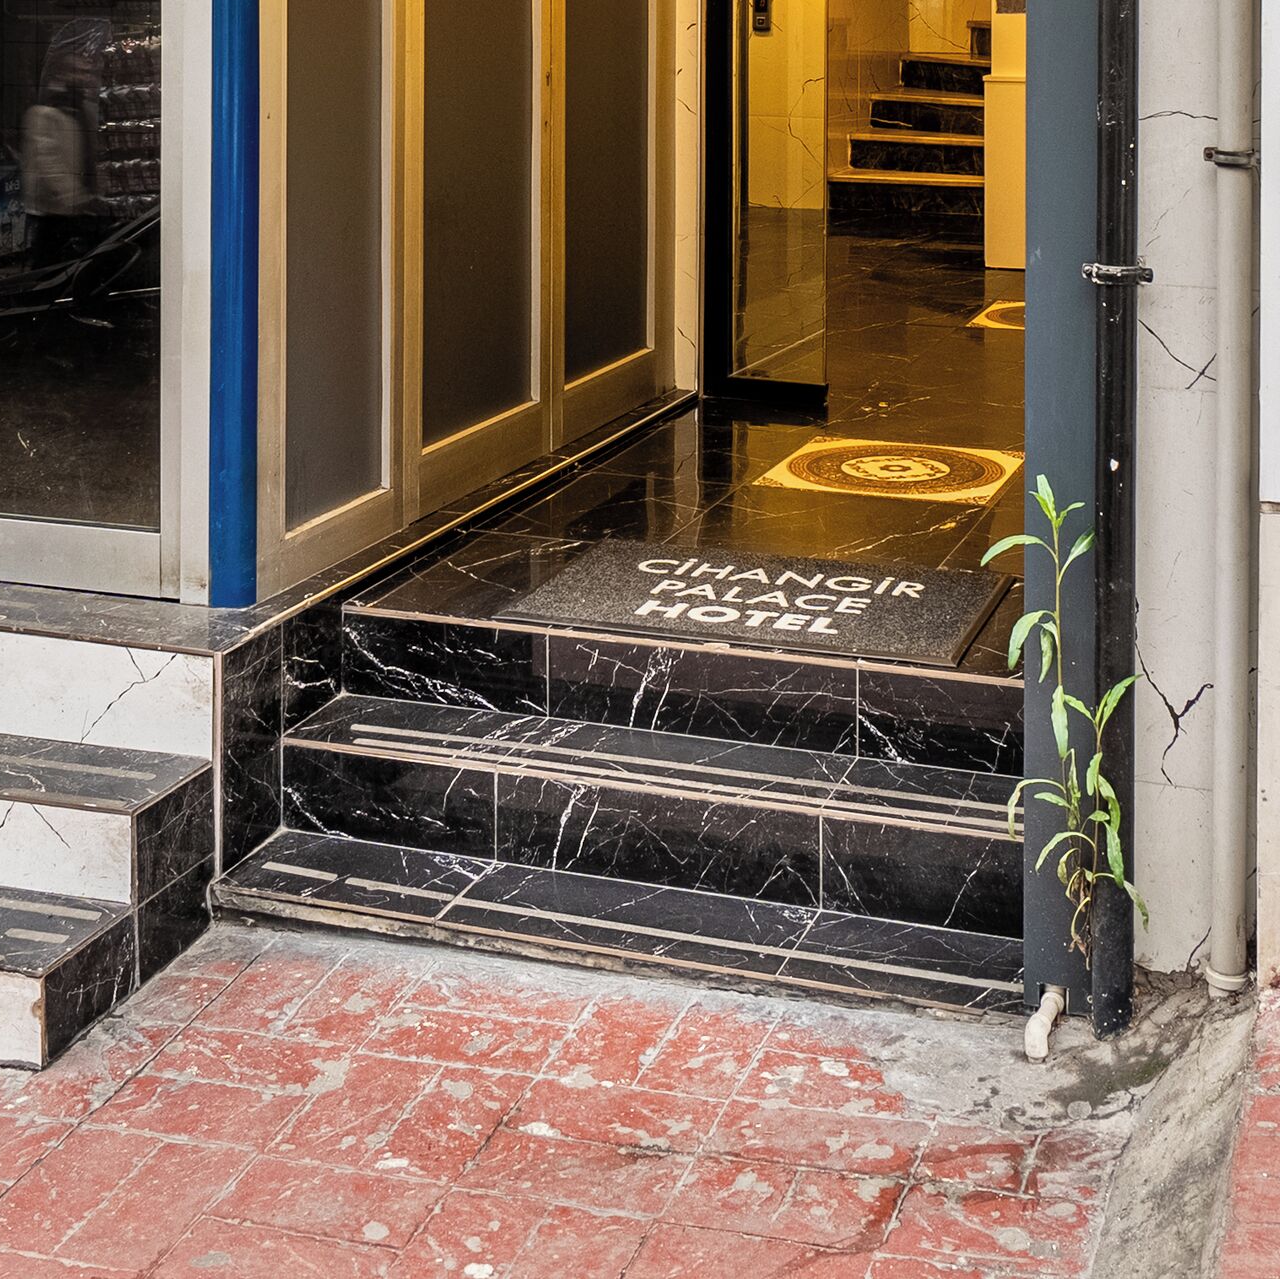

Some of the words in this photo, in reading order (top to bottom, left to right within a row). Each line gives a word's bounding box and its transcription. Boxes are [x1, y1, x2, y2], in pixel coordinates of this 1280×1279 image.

[637, 558, 925, 599] CİHANGİR
[649, 579, 872, 616] PALACE
[634, 599, 840, 635] HOTEL
